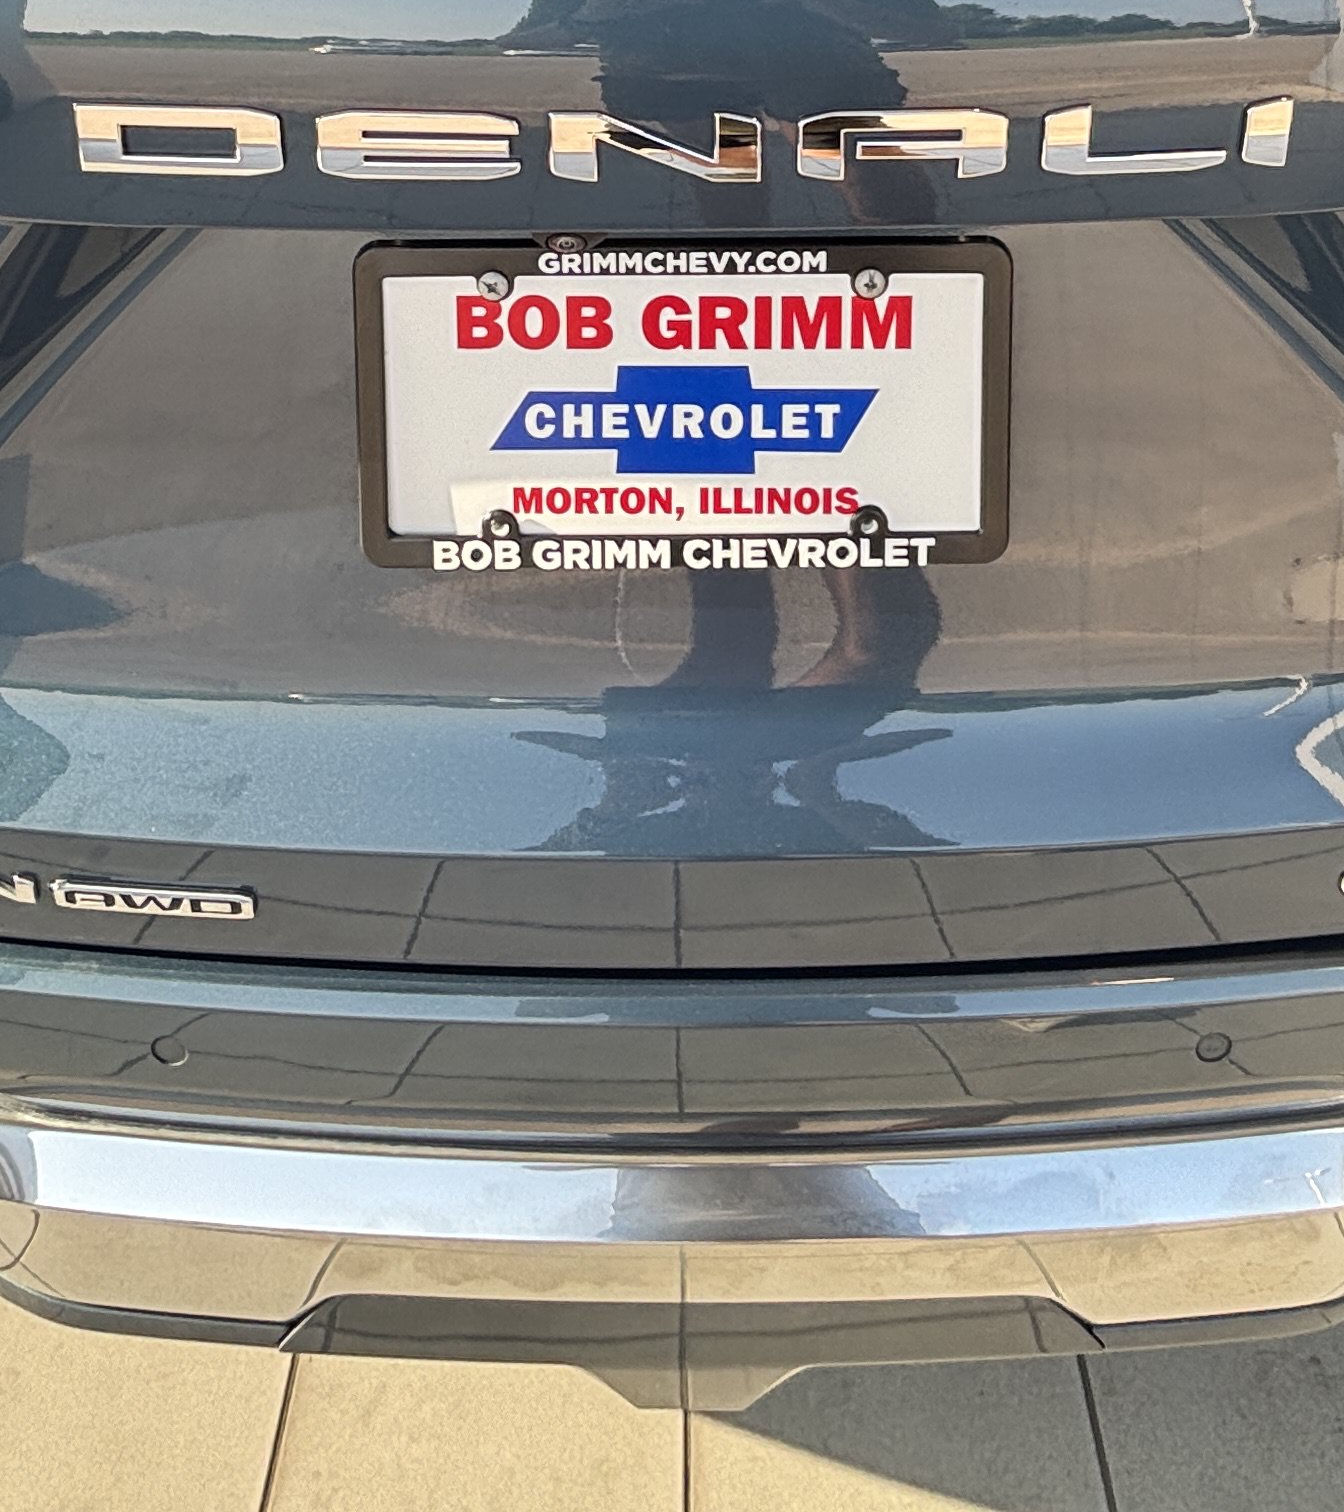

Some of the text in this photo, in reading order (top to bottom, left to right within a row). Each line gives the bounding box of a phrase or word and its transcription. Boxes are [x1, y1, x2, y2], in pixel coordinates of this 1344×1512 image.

[72, 96, 1294, 183] DENALI
[537, 250, 828, 276] GRIMMCHEVY.COM
[456, 295, 913, 350] BOB GRIMM
[524, 402, 842, 440] CHEVROLET
[513, 486, 860, 521] MORTON, ILLINOIS
[433, 537, 936, 572] BOB GRIMM CHEVROLET
[56, 882, 248, 918] AWD
